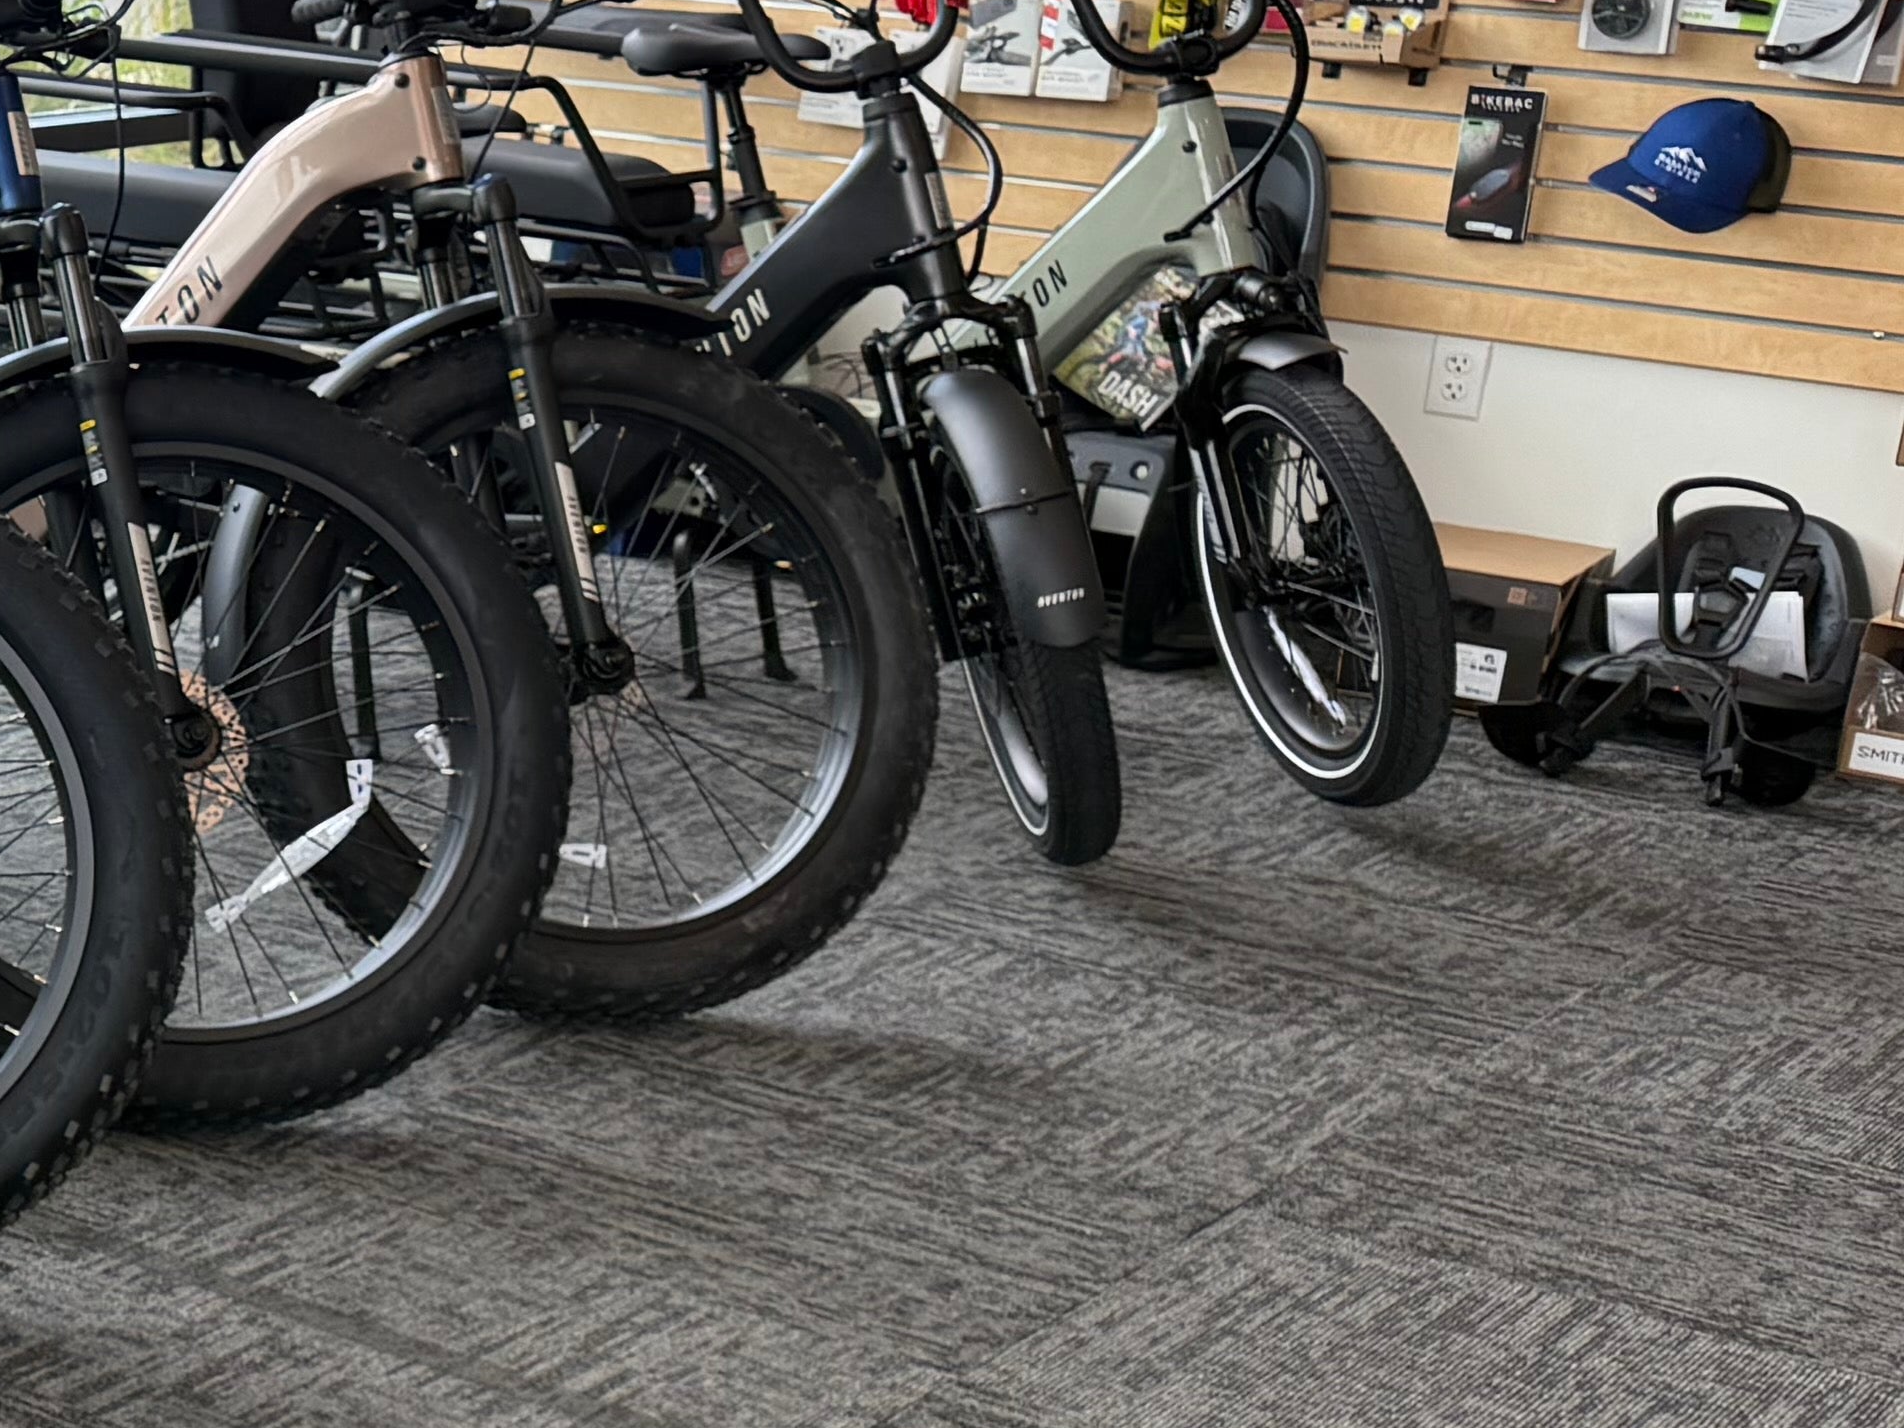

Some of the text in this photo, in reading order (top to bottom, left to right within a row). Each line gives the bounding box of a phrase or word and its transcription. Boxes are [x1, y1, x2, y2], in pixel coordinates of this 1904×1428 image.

[1098, 371, 1159, 417] DASH
[140, 556, 162, 624] AVENTON
[1037, 587, 1085, 608] AVENTON
